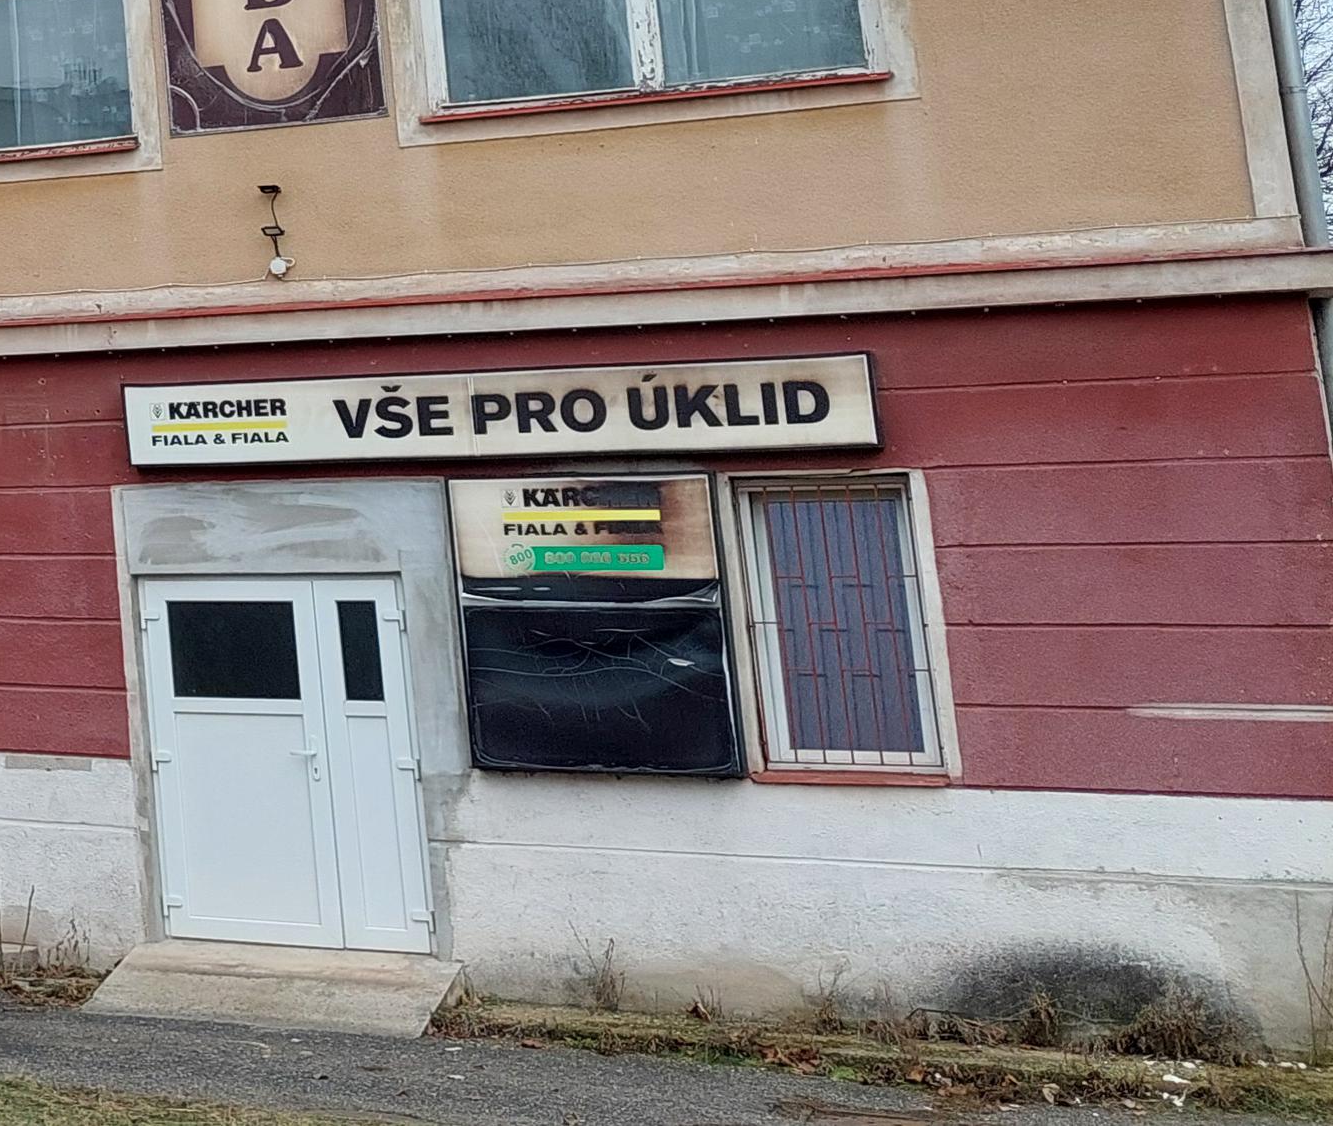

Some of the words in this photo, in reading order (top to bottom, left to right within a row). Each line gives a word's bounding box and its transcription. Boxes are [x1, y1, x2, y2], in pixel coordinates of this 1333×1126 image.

[168, 398, 287, 420] KÄRCHER
[333, 385, 454, 439] VŠE
[471, 388, 607, 435] PRO
[626, 374, 830, 430] ÚKLID
[152, 433, 207, 447] FIALA
[213, 433, 226, 445] &
[231, 431, 289, 445] FIALA
[503, 523, 567, 536] FIALA
[574, 523, 588, 536] &
[509, 548, 534, 566] 800
